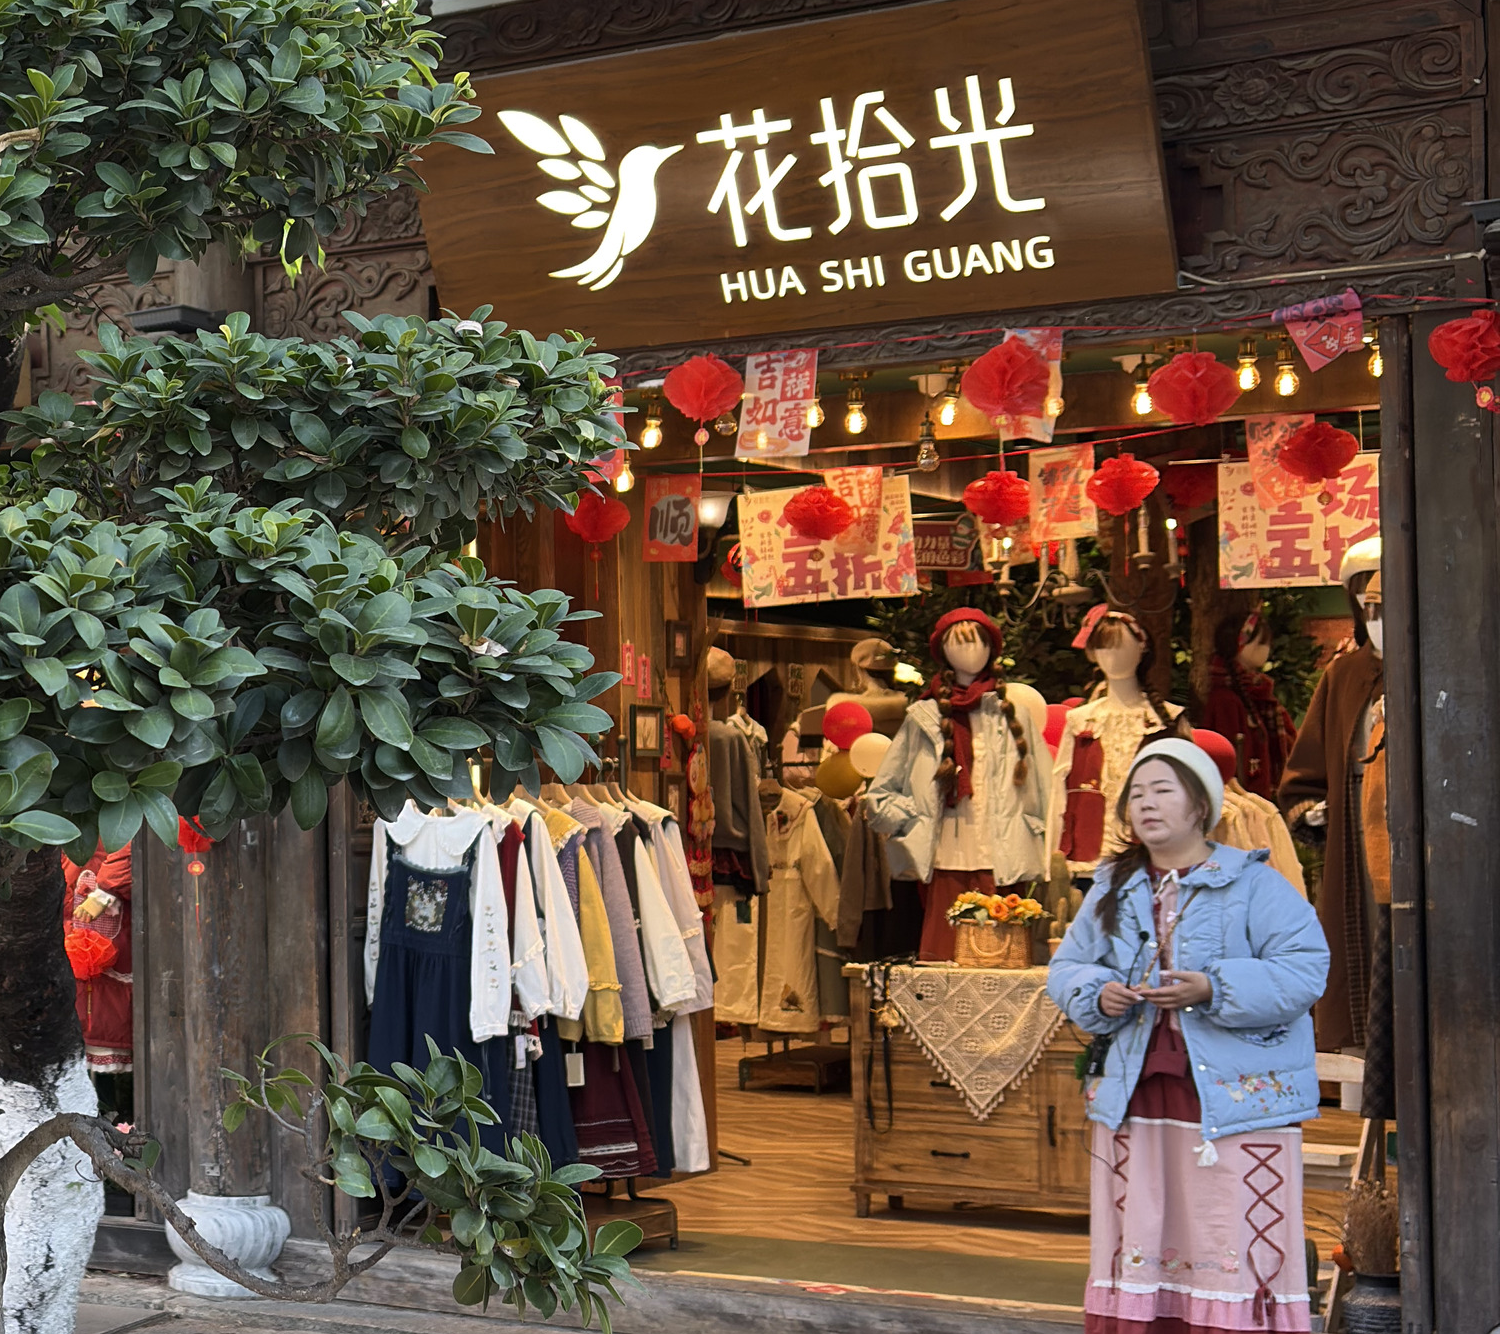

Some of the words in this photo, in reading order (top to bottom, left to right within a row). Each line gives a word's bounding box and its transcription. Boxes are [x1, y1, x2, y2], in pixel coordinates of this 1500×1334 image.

[696, 74, 1046, 247] 花拾光
[721, 265, 808, 304] HUA
[820, 255, 886, 292] SHI
[903, 234, 1056, 285] GUANG
[648, 497, 694, 547] 顺
[781, 551, 884, 597] 五折
